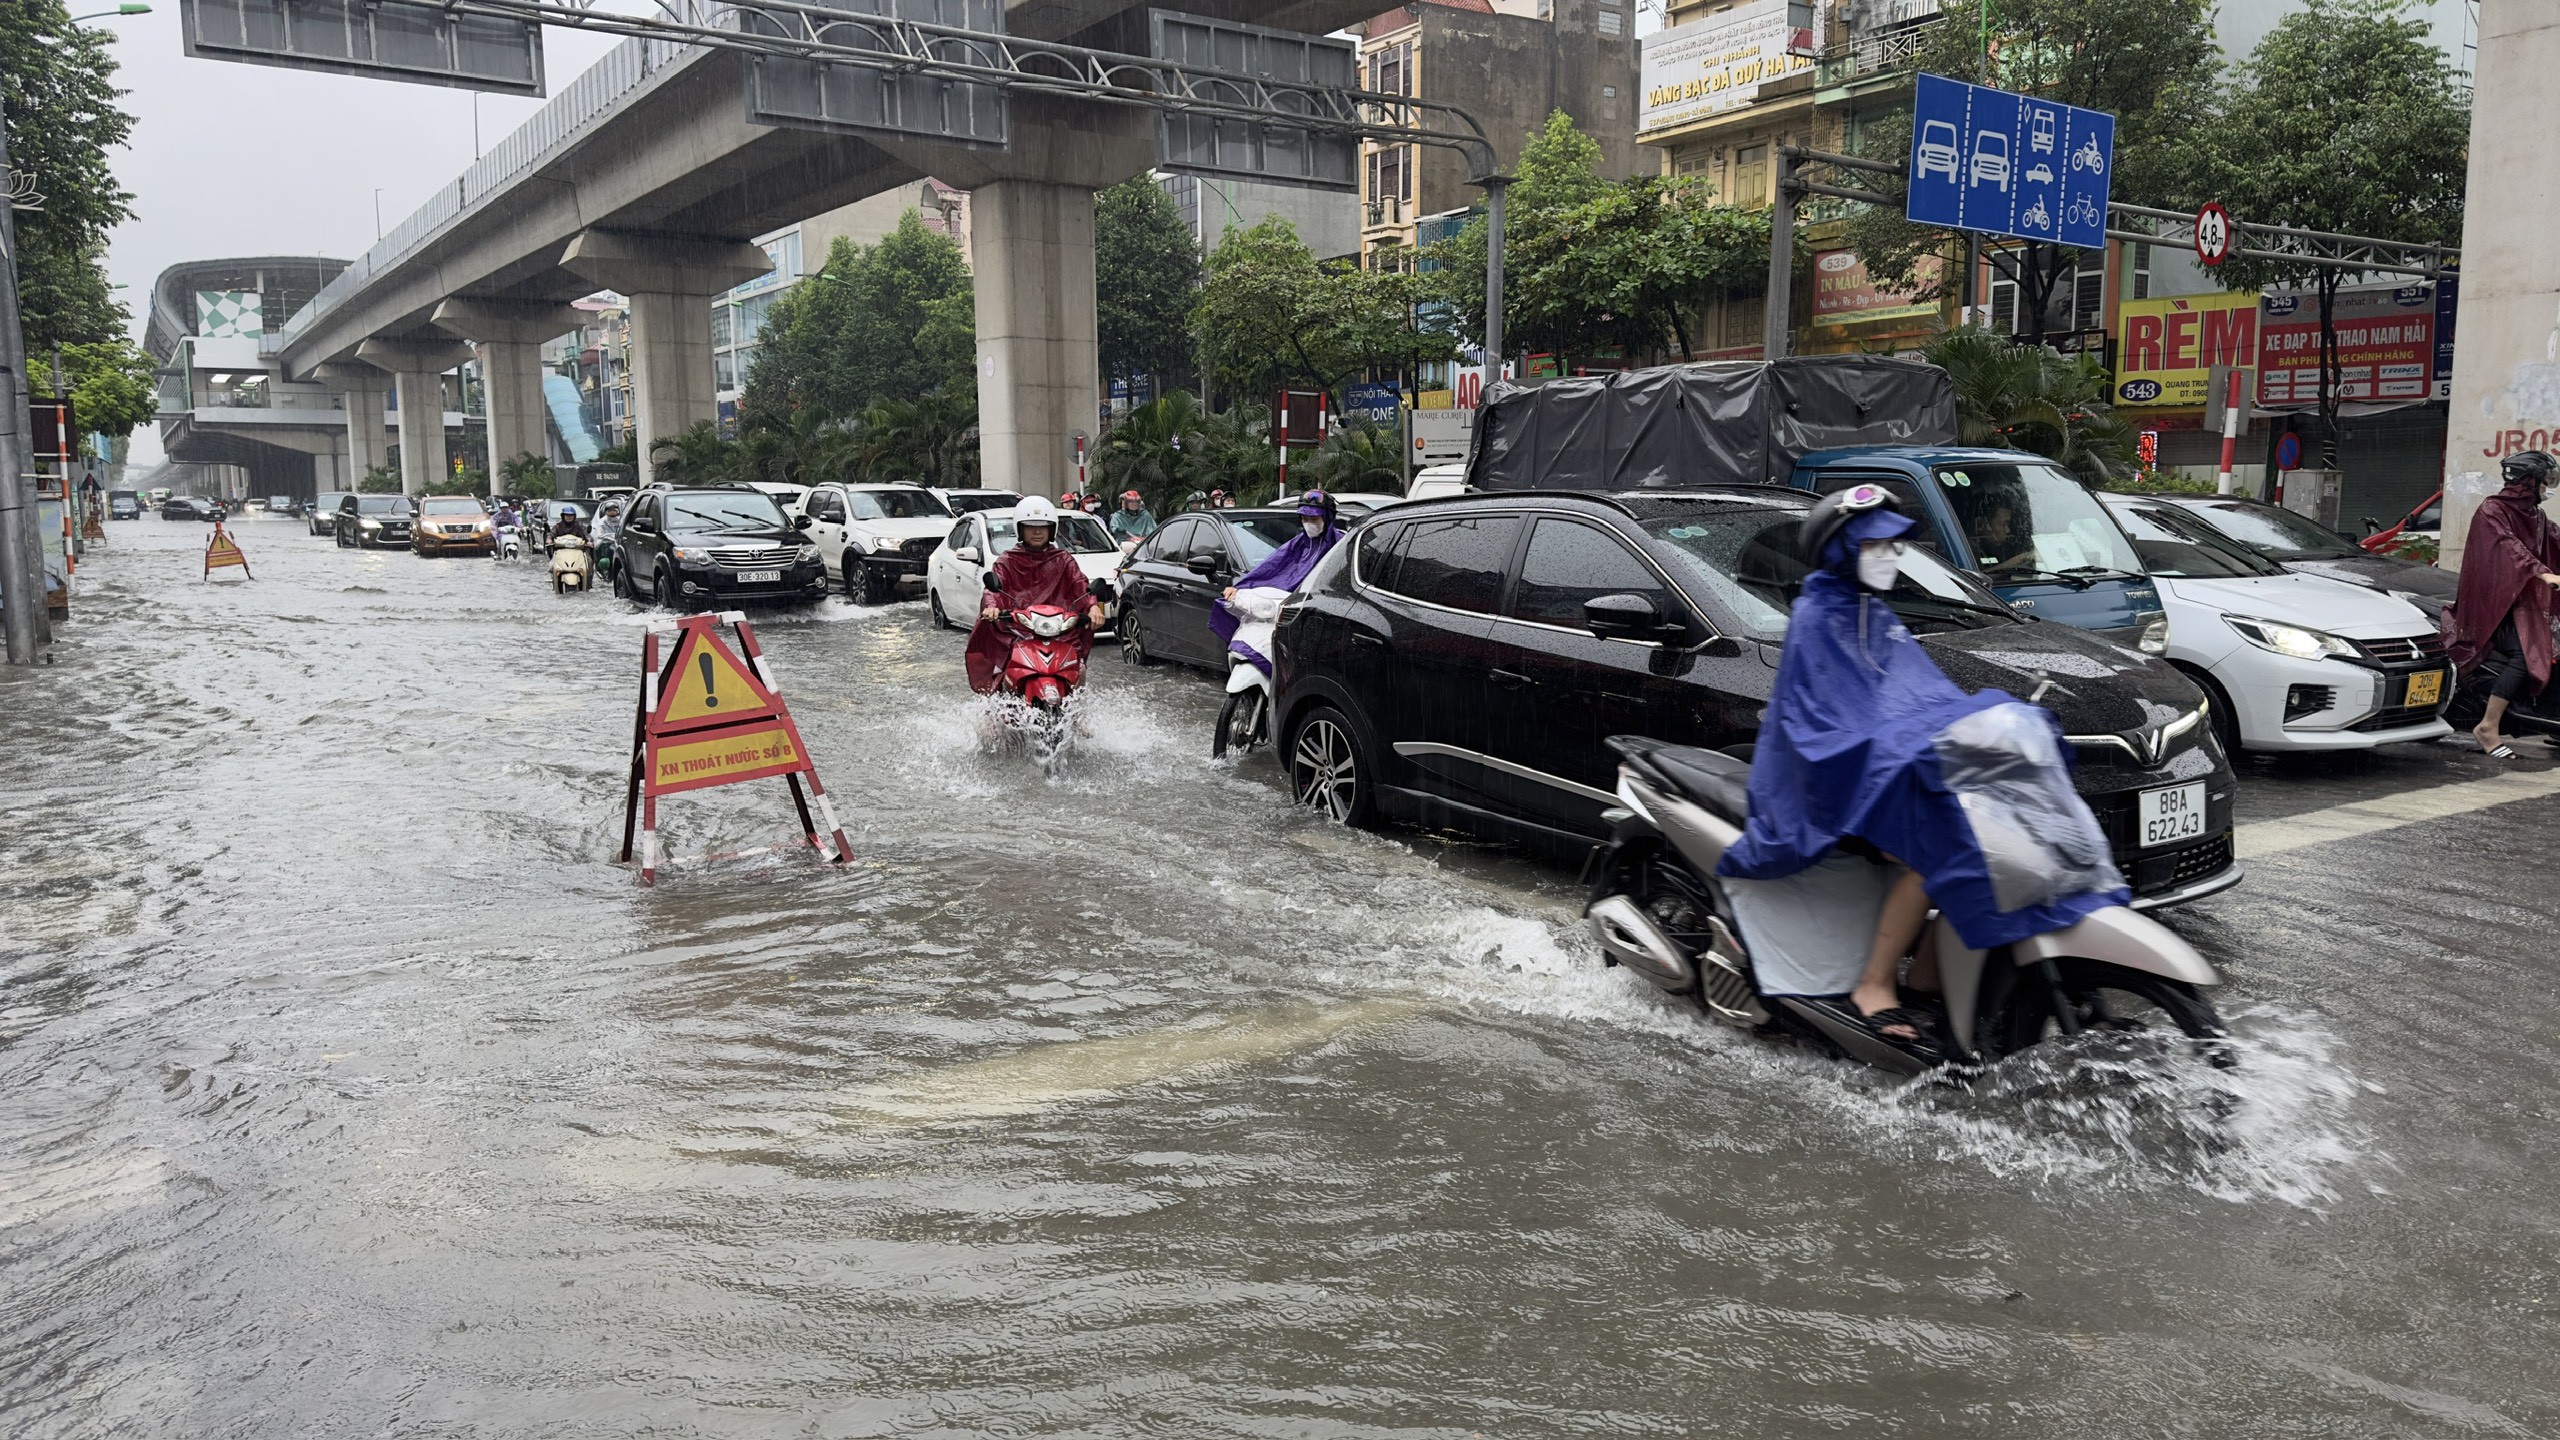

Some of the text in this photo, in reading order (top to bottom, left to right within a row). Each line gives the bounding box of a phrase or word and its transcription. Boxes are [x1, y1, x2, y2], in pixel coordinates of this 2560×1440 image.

[1703, 45, 1761, 69] CHI NHÁNH
[1648, 84, 1681, 108] VÀNG
[1685, 77, 1710, 100] BẠC
[1712, 66, 1731, 93] ĐÁ
[1735, 57, 1763, 85] QUÝ
[1766, 51, 1786, 80] HÀ
[1826, 256, 1848, 270] 539
[1820, 278, 1833, 293] IN
[1835, 271, 1861, 291] MÀU
[2271, 296, 2292, 308] 545
[2123, 299, 2258, 373] RÈM
[2265, 334, 2281, 351] XE
[2283, 332, 2308, 353] ĐẠP
[2337, 328, 2367, 348] THAO
[2370, 326, 2400, 345] NAM
[2404, 318, 2426, 342] HẢI
[2279, 355, 2298, 367] BÁN
[2350, 351, 2382, 363] CHÍNH
[2381, 366, 2421, 374] TRINX
[2126, 382, 2156, 399] 543
[2165, 379, 2209, 389] QUANG TRUN
[1363, 387, 1376, 401] NỘI
[1372, 406, 1395, 421] ONE
[1416, 411, 1464, 422] MARIE CURIE
[660, 741, 792, 777] XN THOÁT NƯỚC SỐ 8
[2160, 788, 2188, 815] 88A
[2148, 812, 2199, 842] 622.43
